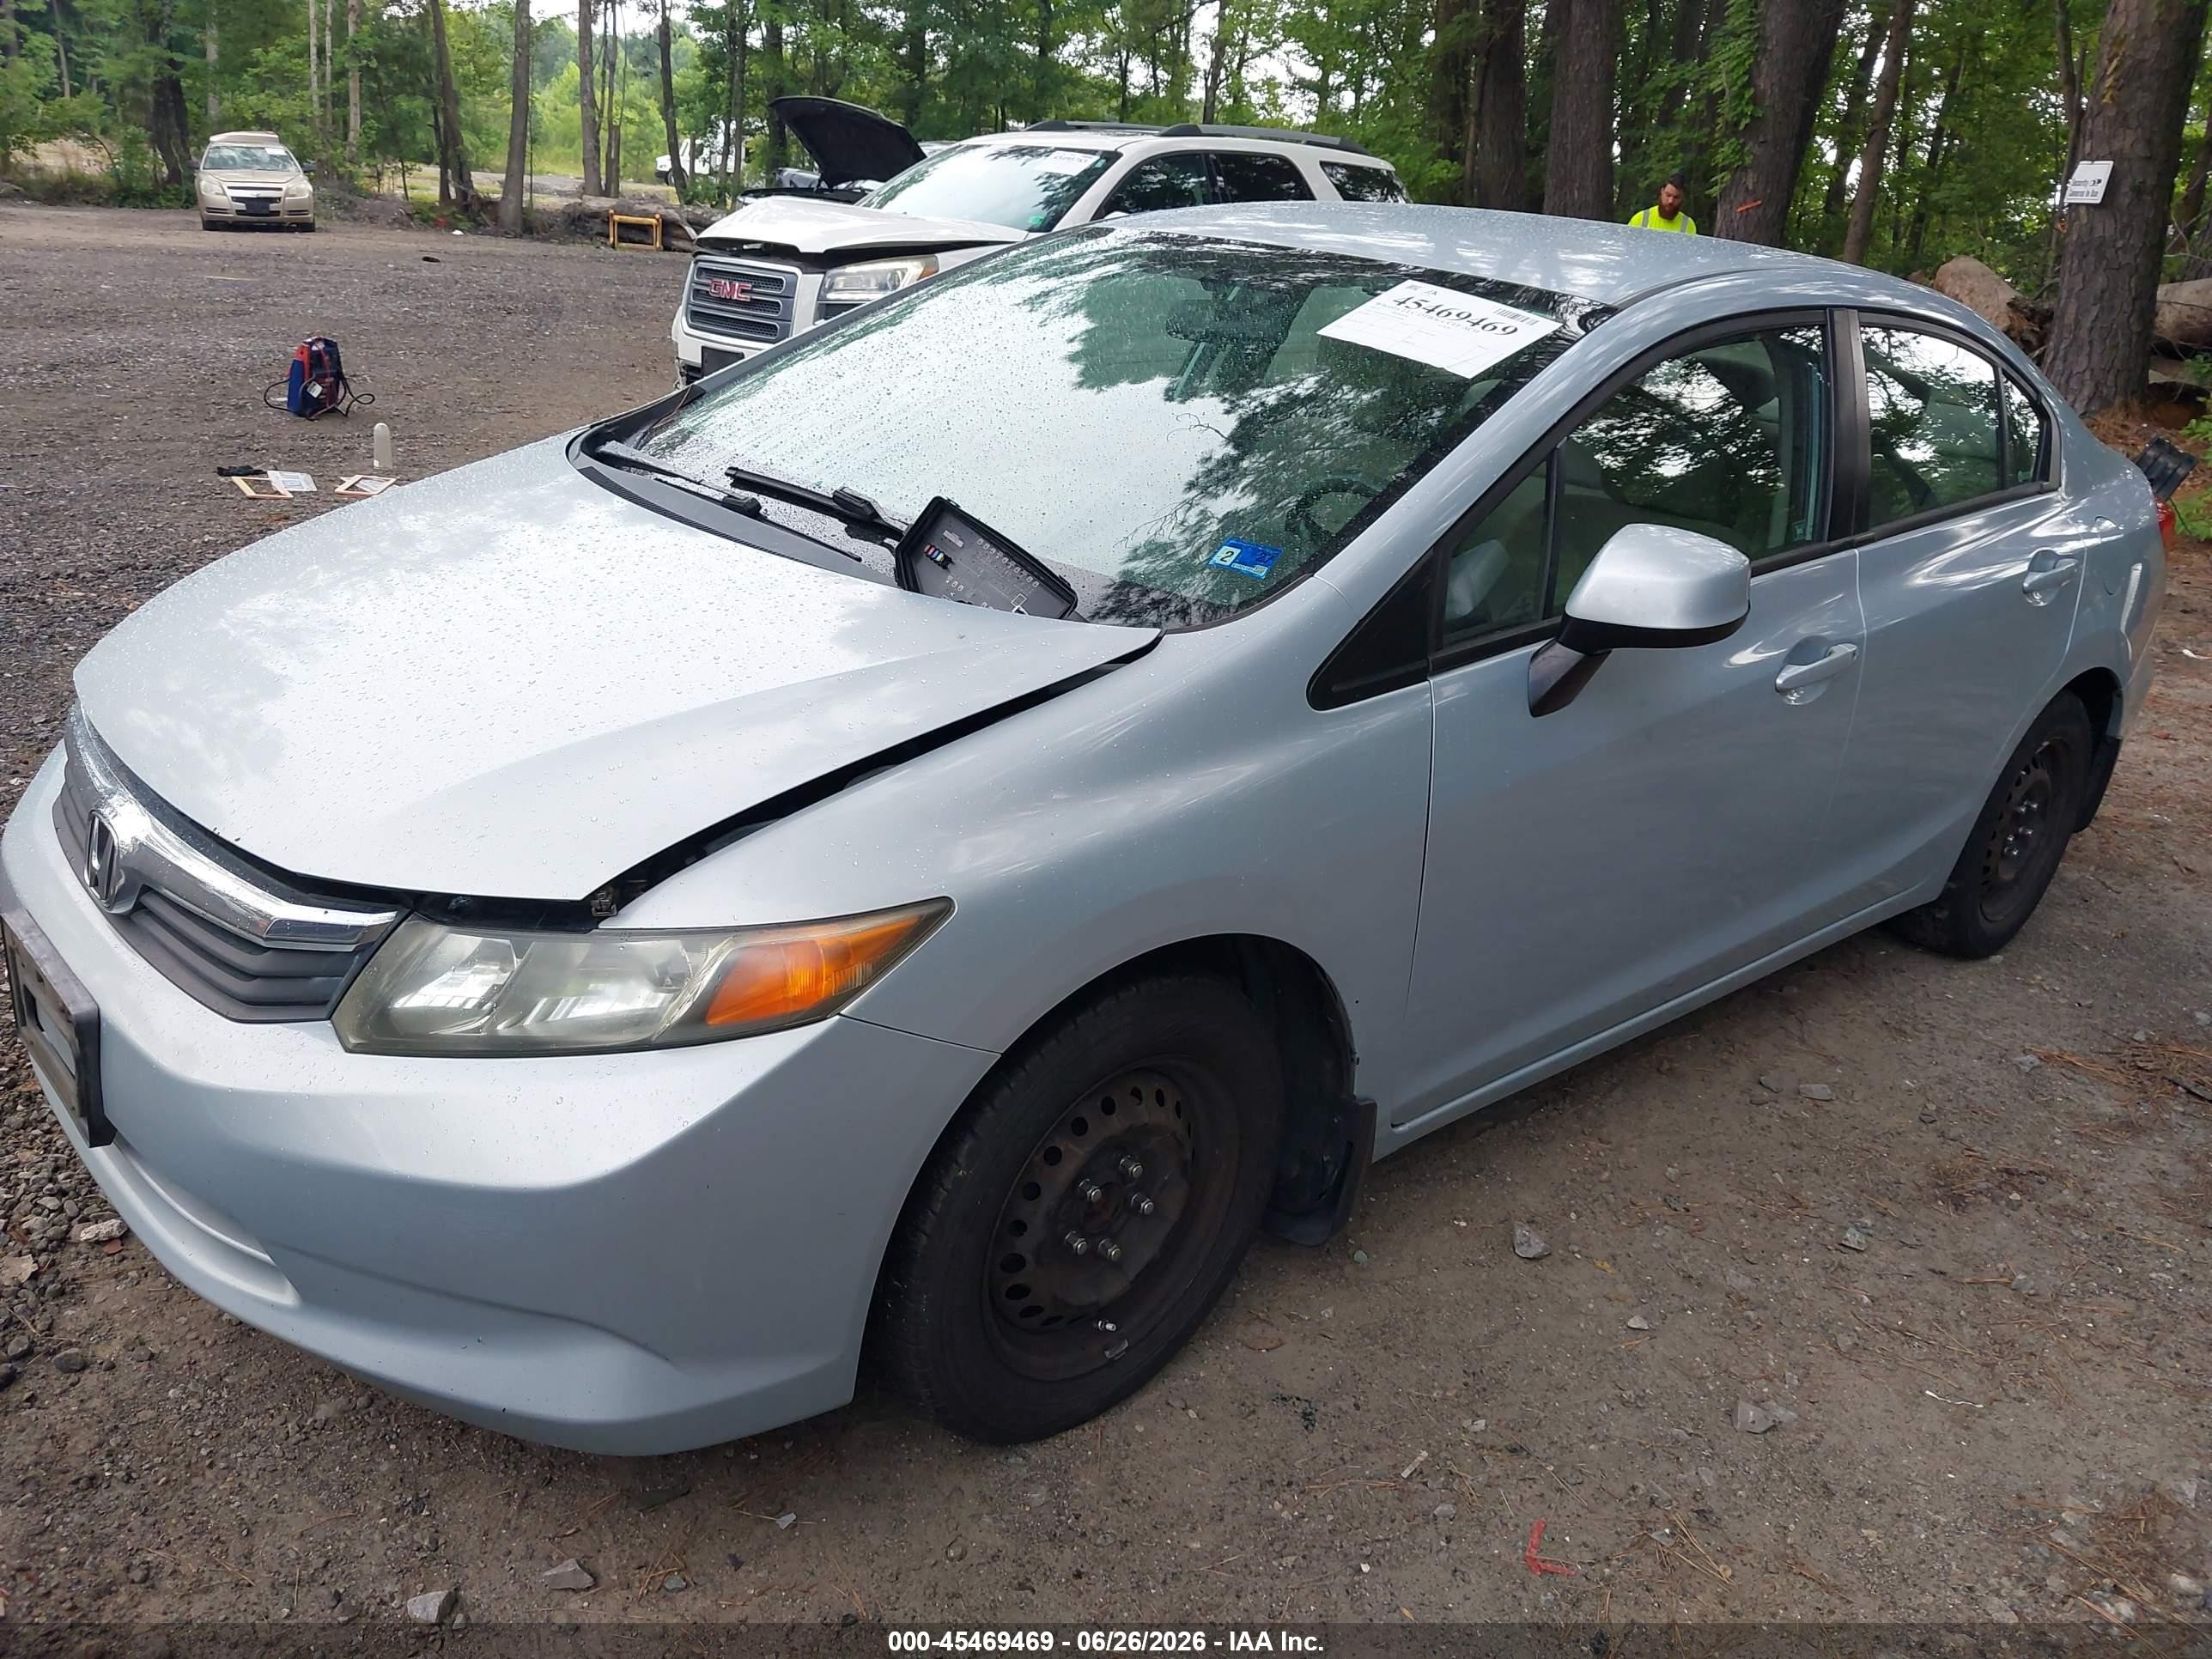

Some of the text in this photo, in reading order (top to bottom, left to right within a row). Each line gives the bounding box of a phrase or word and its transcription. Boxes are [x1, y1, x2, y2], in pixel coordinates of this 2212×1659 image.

[709, 277, 752, 302] GMC
[1392, 296, 1518, 336] 45469469
[1219, 550, 1235, 562] 2
